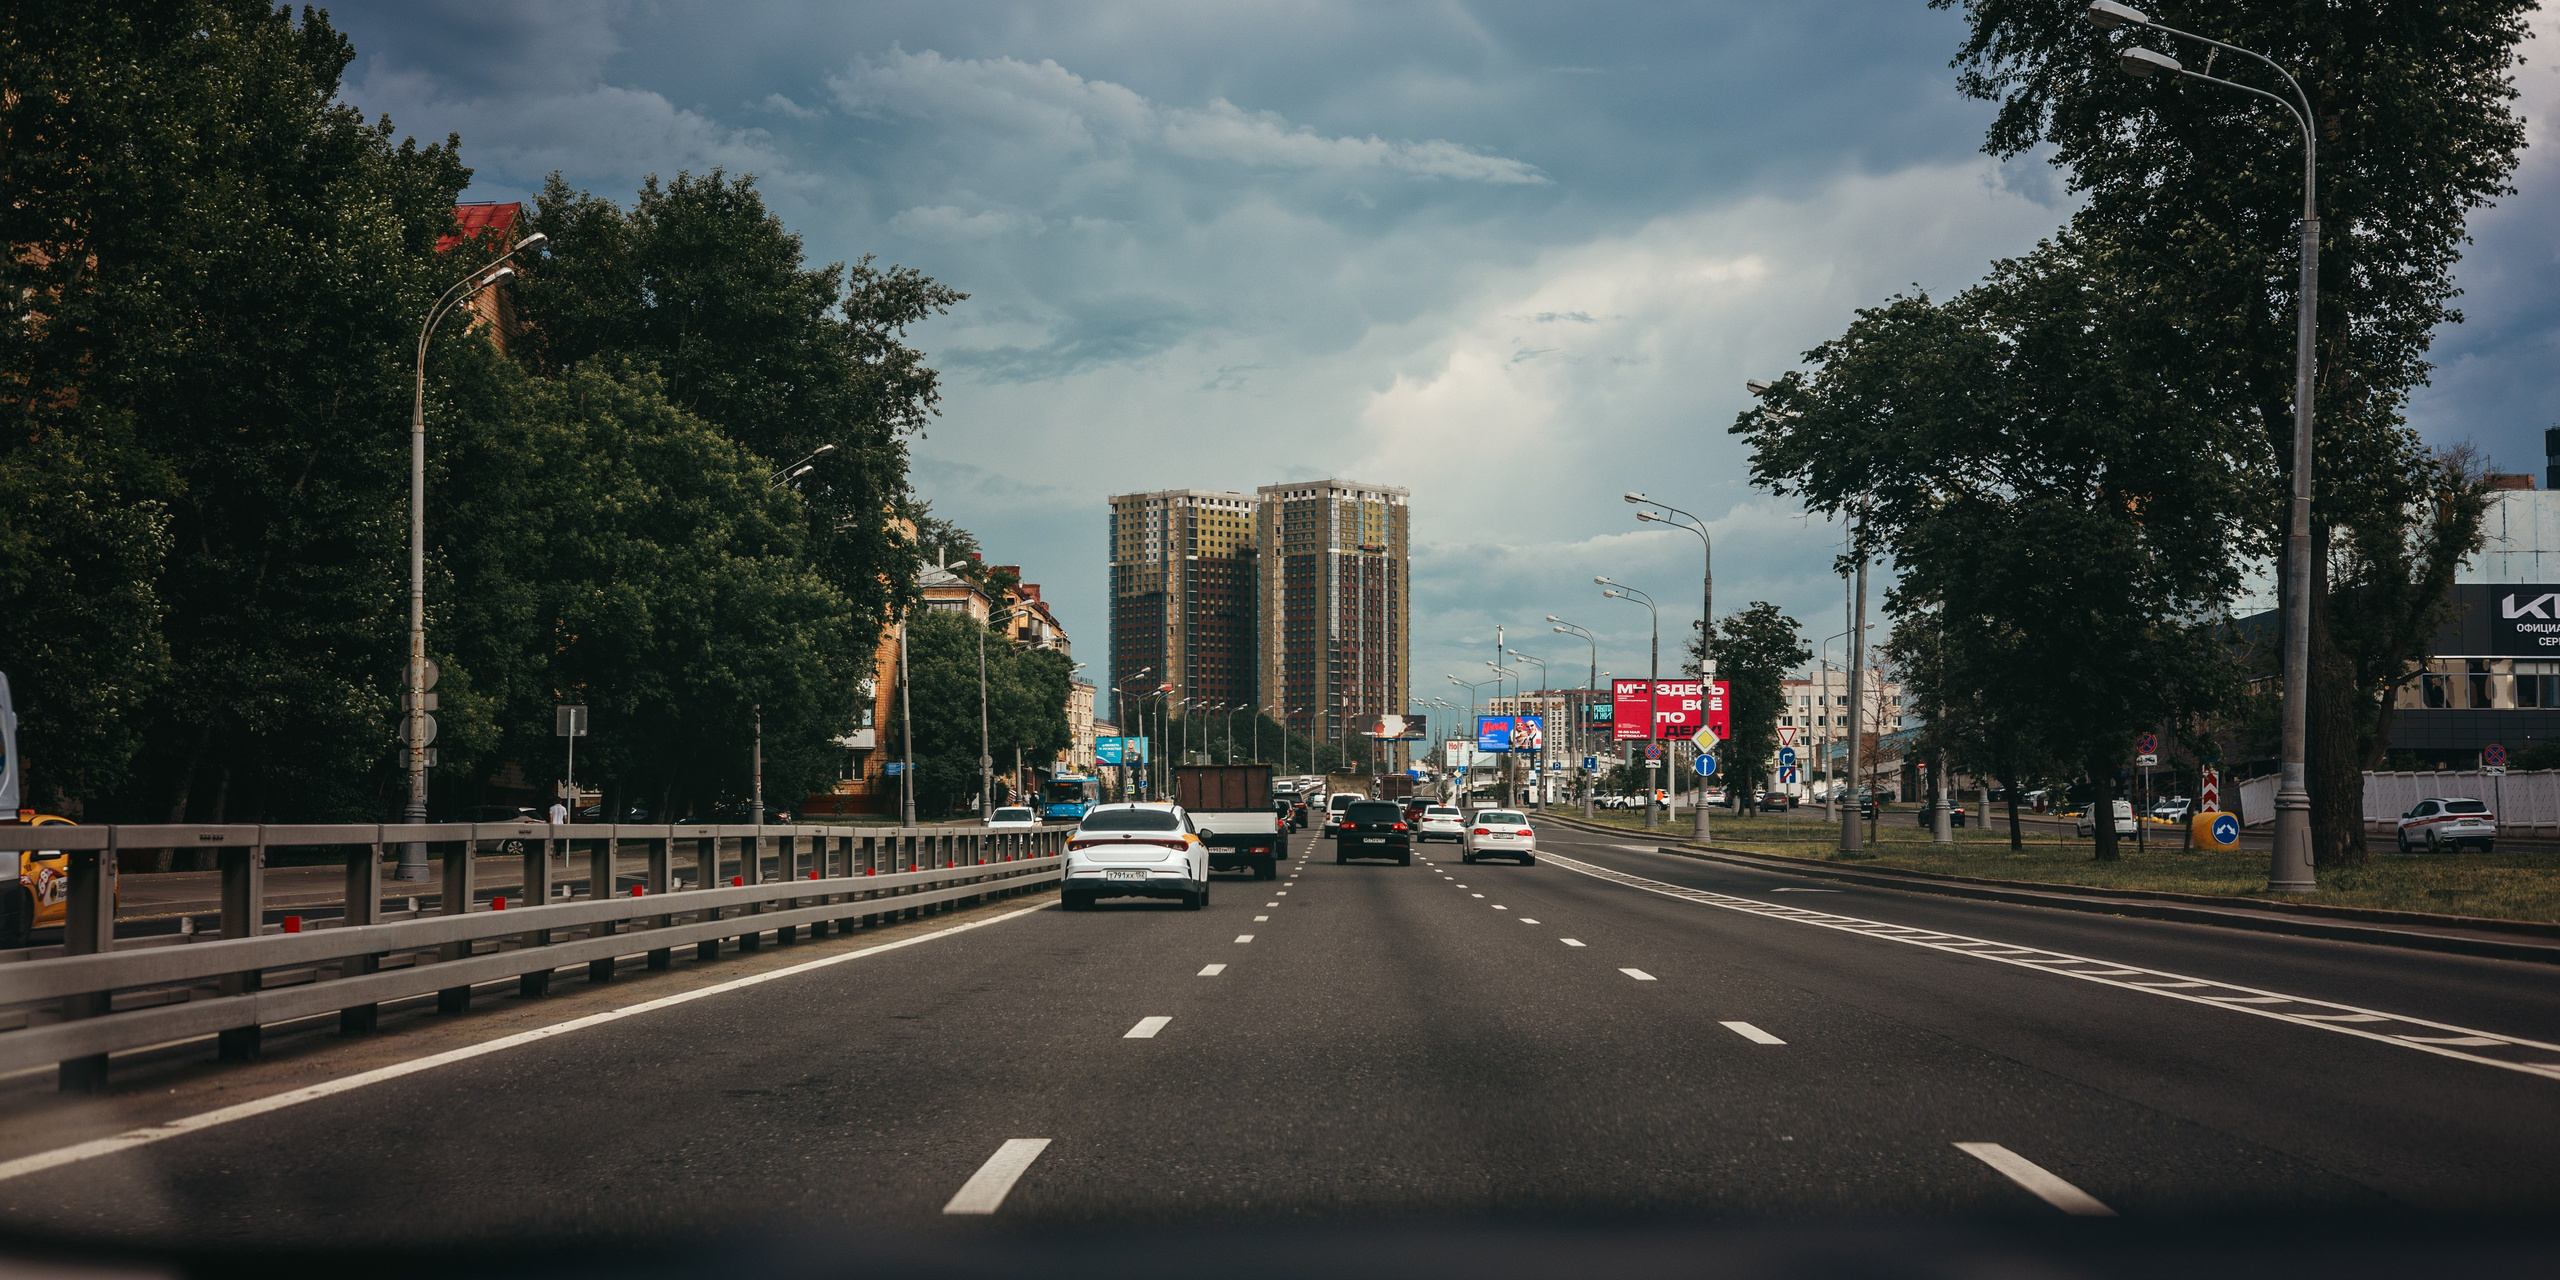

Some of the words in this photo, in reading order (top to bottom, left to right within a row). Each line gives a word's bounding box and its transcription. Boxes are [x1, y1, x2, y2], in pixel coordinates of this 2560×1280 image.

[2538, 637, 2560, 646] СЕР
[1656, 684, 1725, 696] ЗДЕСЬ
[1656, 712, 1685, 723] ПО
[1664, 726, 1722, 737] ДЕ!
